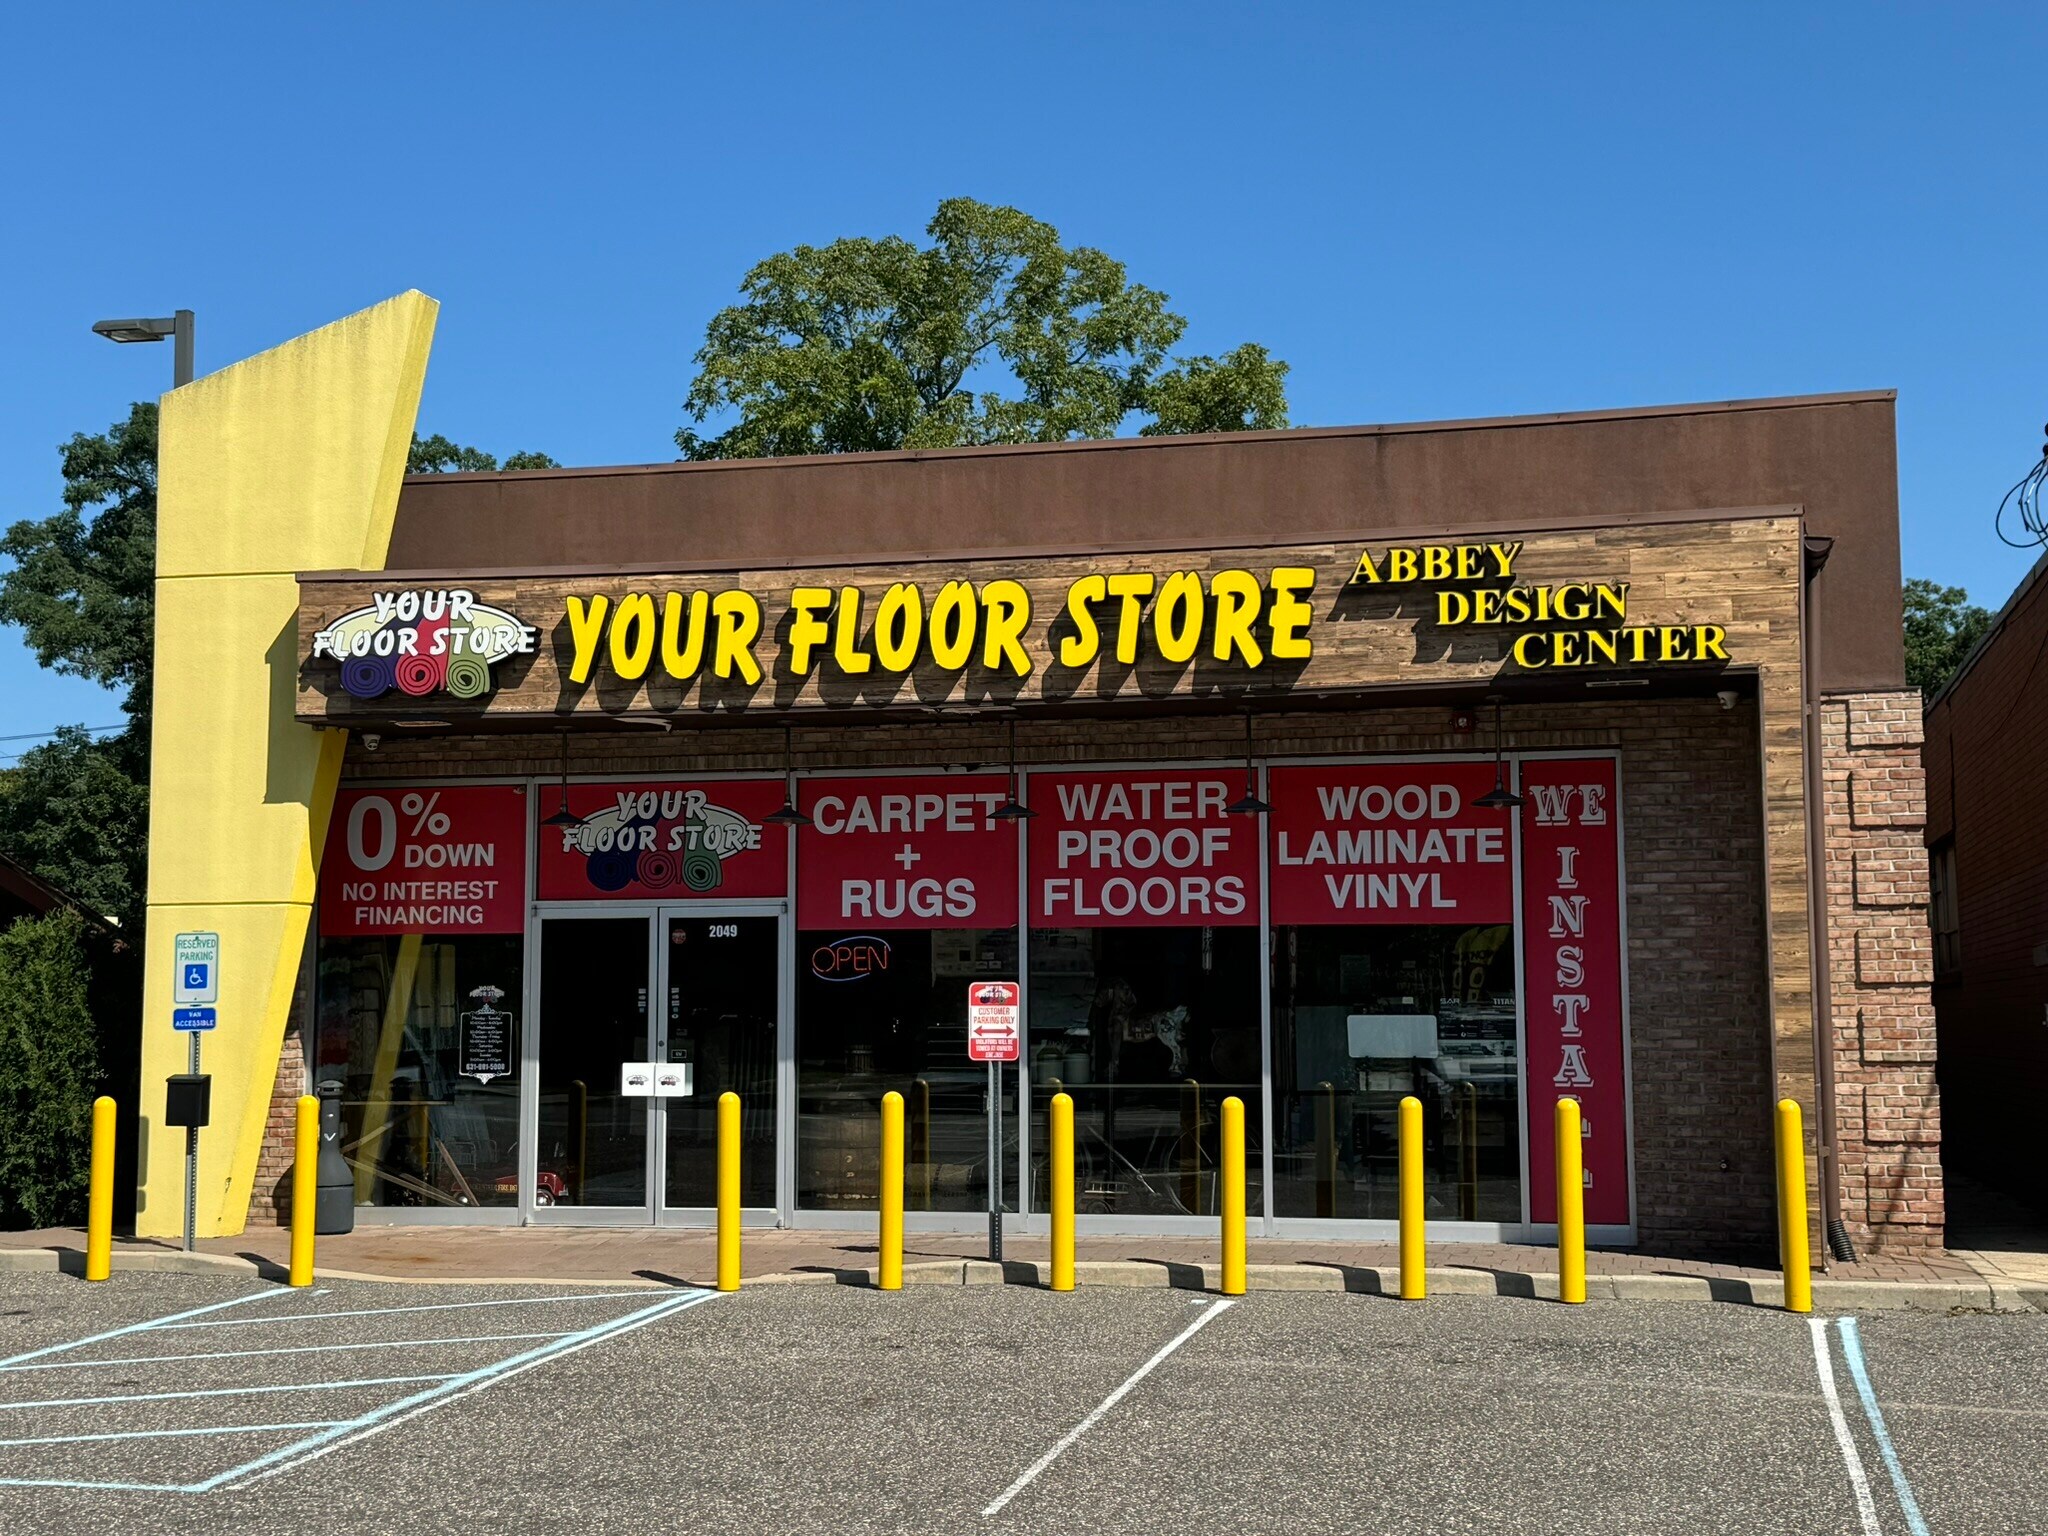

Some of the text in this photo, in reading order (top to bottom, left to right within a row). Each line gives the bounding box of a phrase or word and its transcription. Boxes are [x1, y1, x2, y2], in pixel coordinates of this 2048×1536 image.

[1349, 541, 1524, 585] ABBEY
[373, 588, 474, 625] YOUR
[1435, 583, 1629, 626] DESIGN
[314, 625, 536, 658] FLOOR STORE
[566, 567, 1316, 685] YOUR FLOOR STORE
[1513, 624, 1731, 669] CENTER
[616, 790, 708, 822] YOUR
[812, 792, 1006, 835] CARPET
[1056, 781, 1229, 822] WATER
[1316, 784, 1461, 821] WOOD
[1529, 784, 1607, 827] WE
[404, 843, 495, 868] DOWN
[563, 823, 764, 853] FLOOR STORE
[1057, 827, 1231, 869] PROOF
[1278, 827, 1505, 866] LAMINATE
[342, 880, 499, 902] NO INTEREST
[841, 878, 976, 919] RUGS
[1044, 876, 1246, 917] FLOORS
[1324, 872, 1457, 909] VINYL
[355, 905, 484, 926] FINANCING
[709, 924, 738, 938] 2049
[177, 939, 216, 949] RESERVED
[180, 951, 213, 961] PARKING
[812, 945, 888, 973] OPEN
[175, 1019, 215, 1027] ACCESSIBLE
[974, 1016, 1015, 1024] PARKING ONLY
[978, 1007, 1010, 1015] CUSTOMER
[1547, 846, 1593, 1189] INSTA
